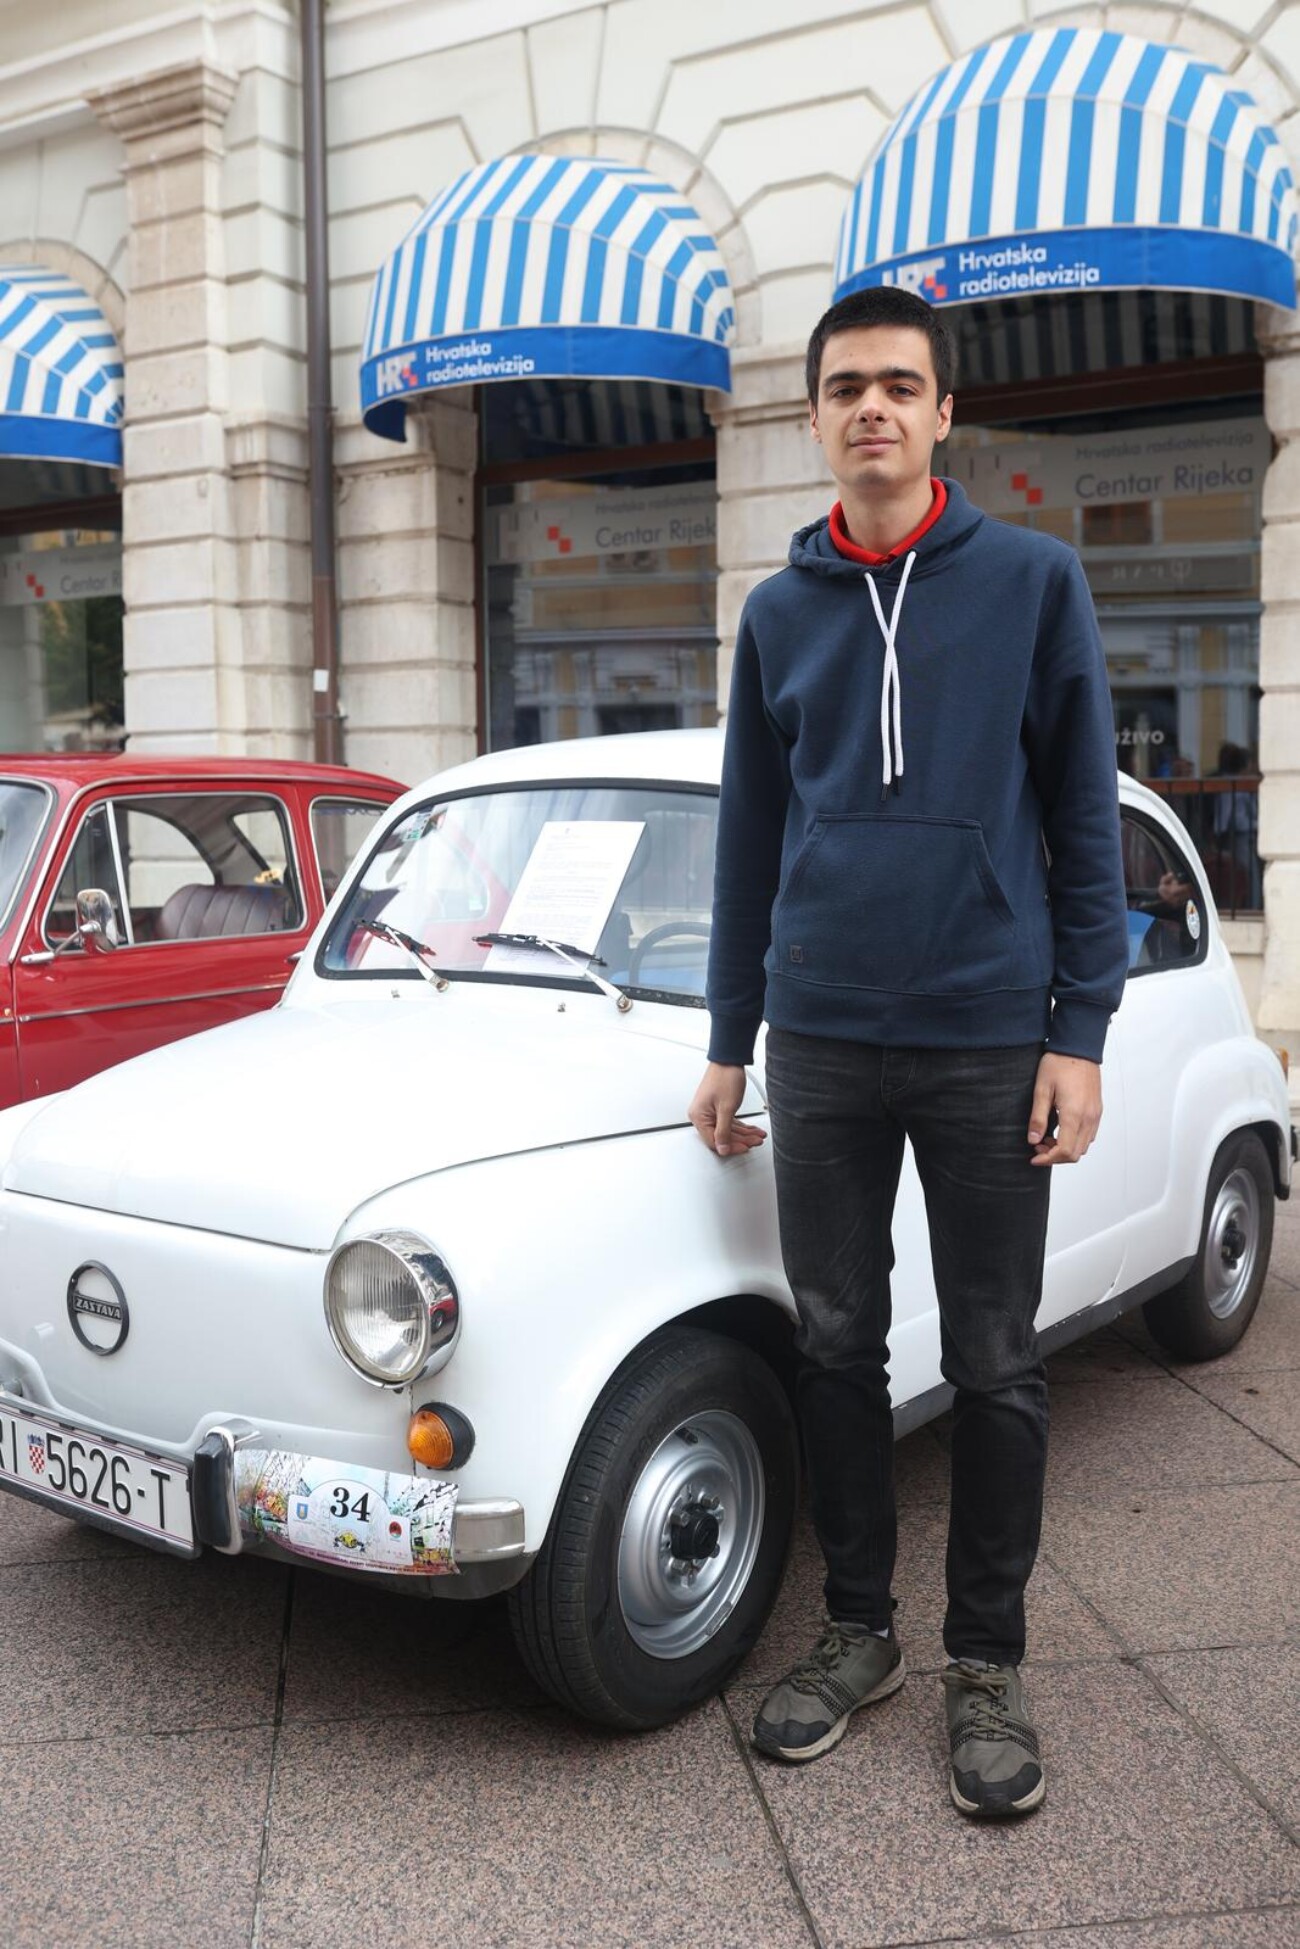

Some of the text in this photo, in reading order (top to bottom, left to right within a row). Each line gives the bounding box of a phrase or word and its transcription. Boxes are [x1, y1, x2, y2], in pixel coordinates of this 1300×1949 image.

[959, 243, 1047, 273] Hrvatska
[959, 263, 1100, 296] radiotelevizija
[425, 339, 492, 363] Hrvatska
[376, 351, 417, 398] HRT
[426, 355, 535, 383] radiotelevizija
[1075, 473, 1164, 499] Centar
[1173, 459, 1254, 493] Rijeka
[595, 525, 662, 548] Centar
[669, 516, 717, 545] Rijek
[76, 1298, 121, 1319] ZASTAVA
[0, 1418, 171, 1530] I 5626-T
[329, 1486, 371, 1523] 34
